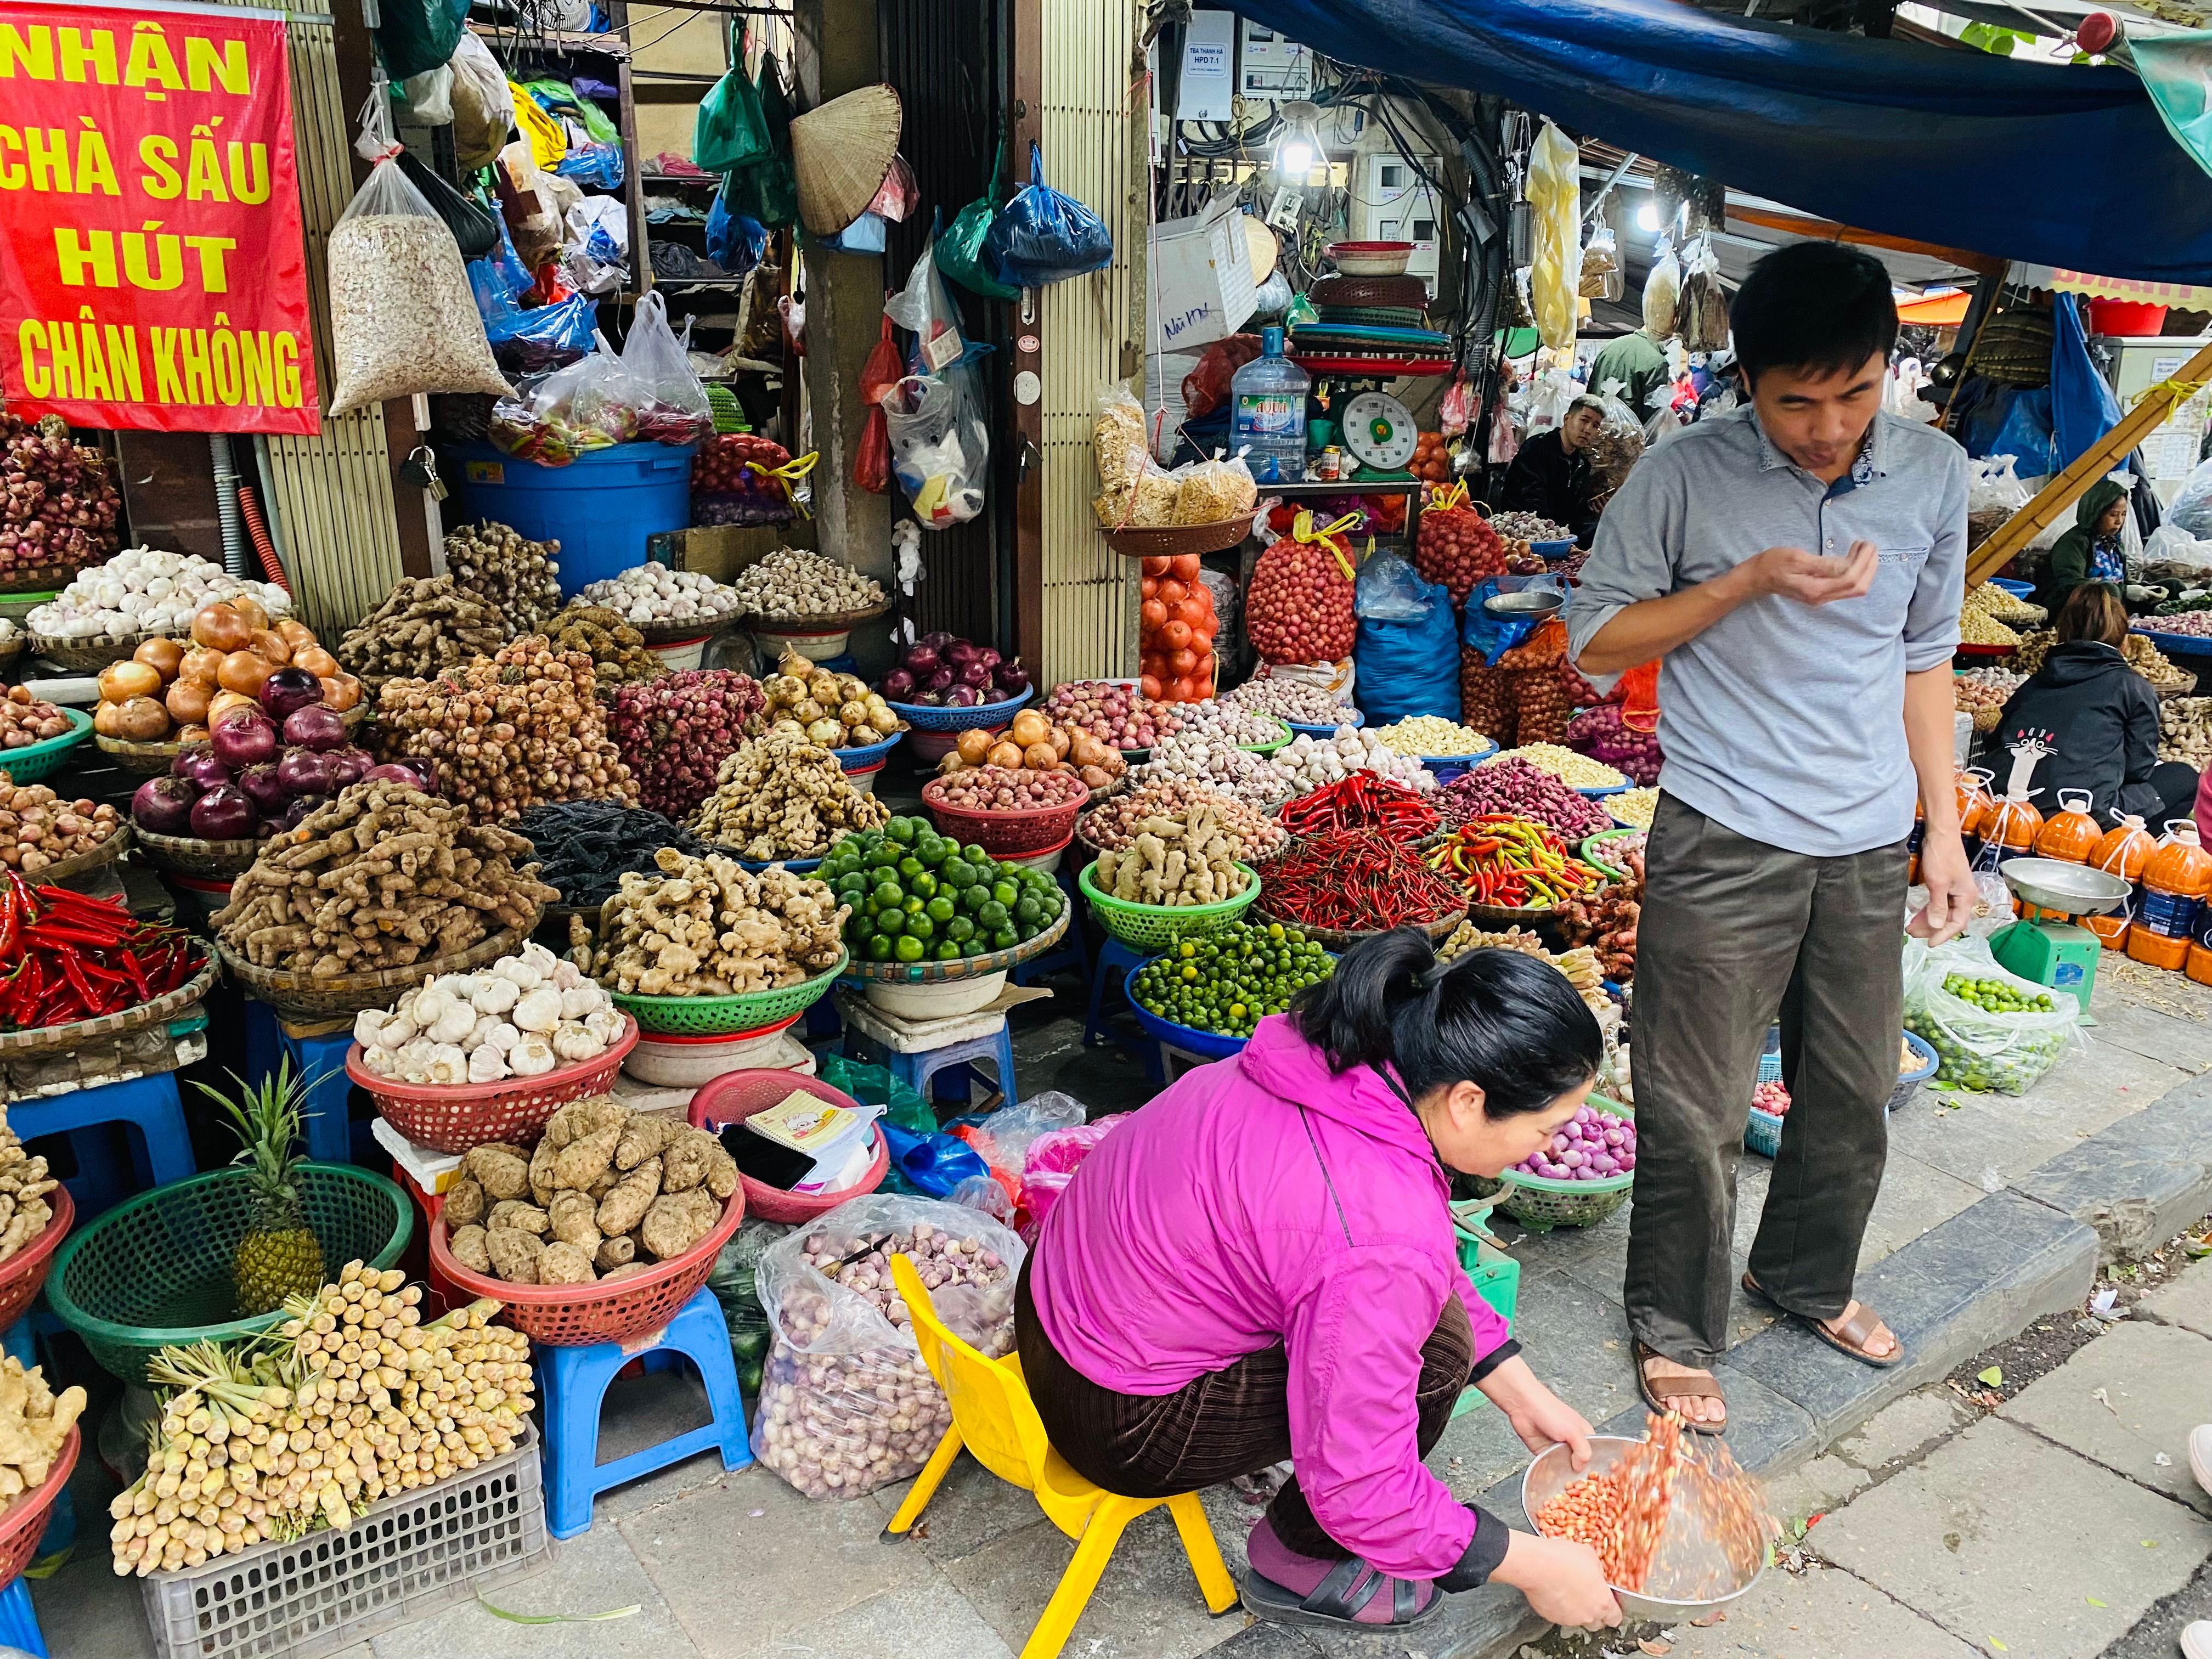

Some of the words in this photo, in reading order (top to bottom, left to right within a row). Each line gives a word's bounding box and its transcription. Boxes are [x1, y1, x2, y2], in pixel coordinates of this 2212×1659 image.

[0, 21, 250, 101] NHẬN
[0, 116, 121, 196] CHÀ
[139, 116, 270, 205] SẤU
[54, 220, 236, 293] HÚT
[19, 305, 144, 403] CHÂN
[150, 312, 302, 409] KHÔNG
[1256, 401, 1287, 414] AQUA
